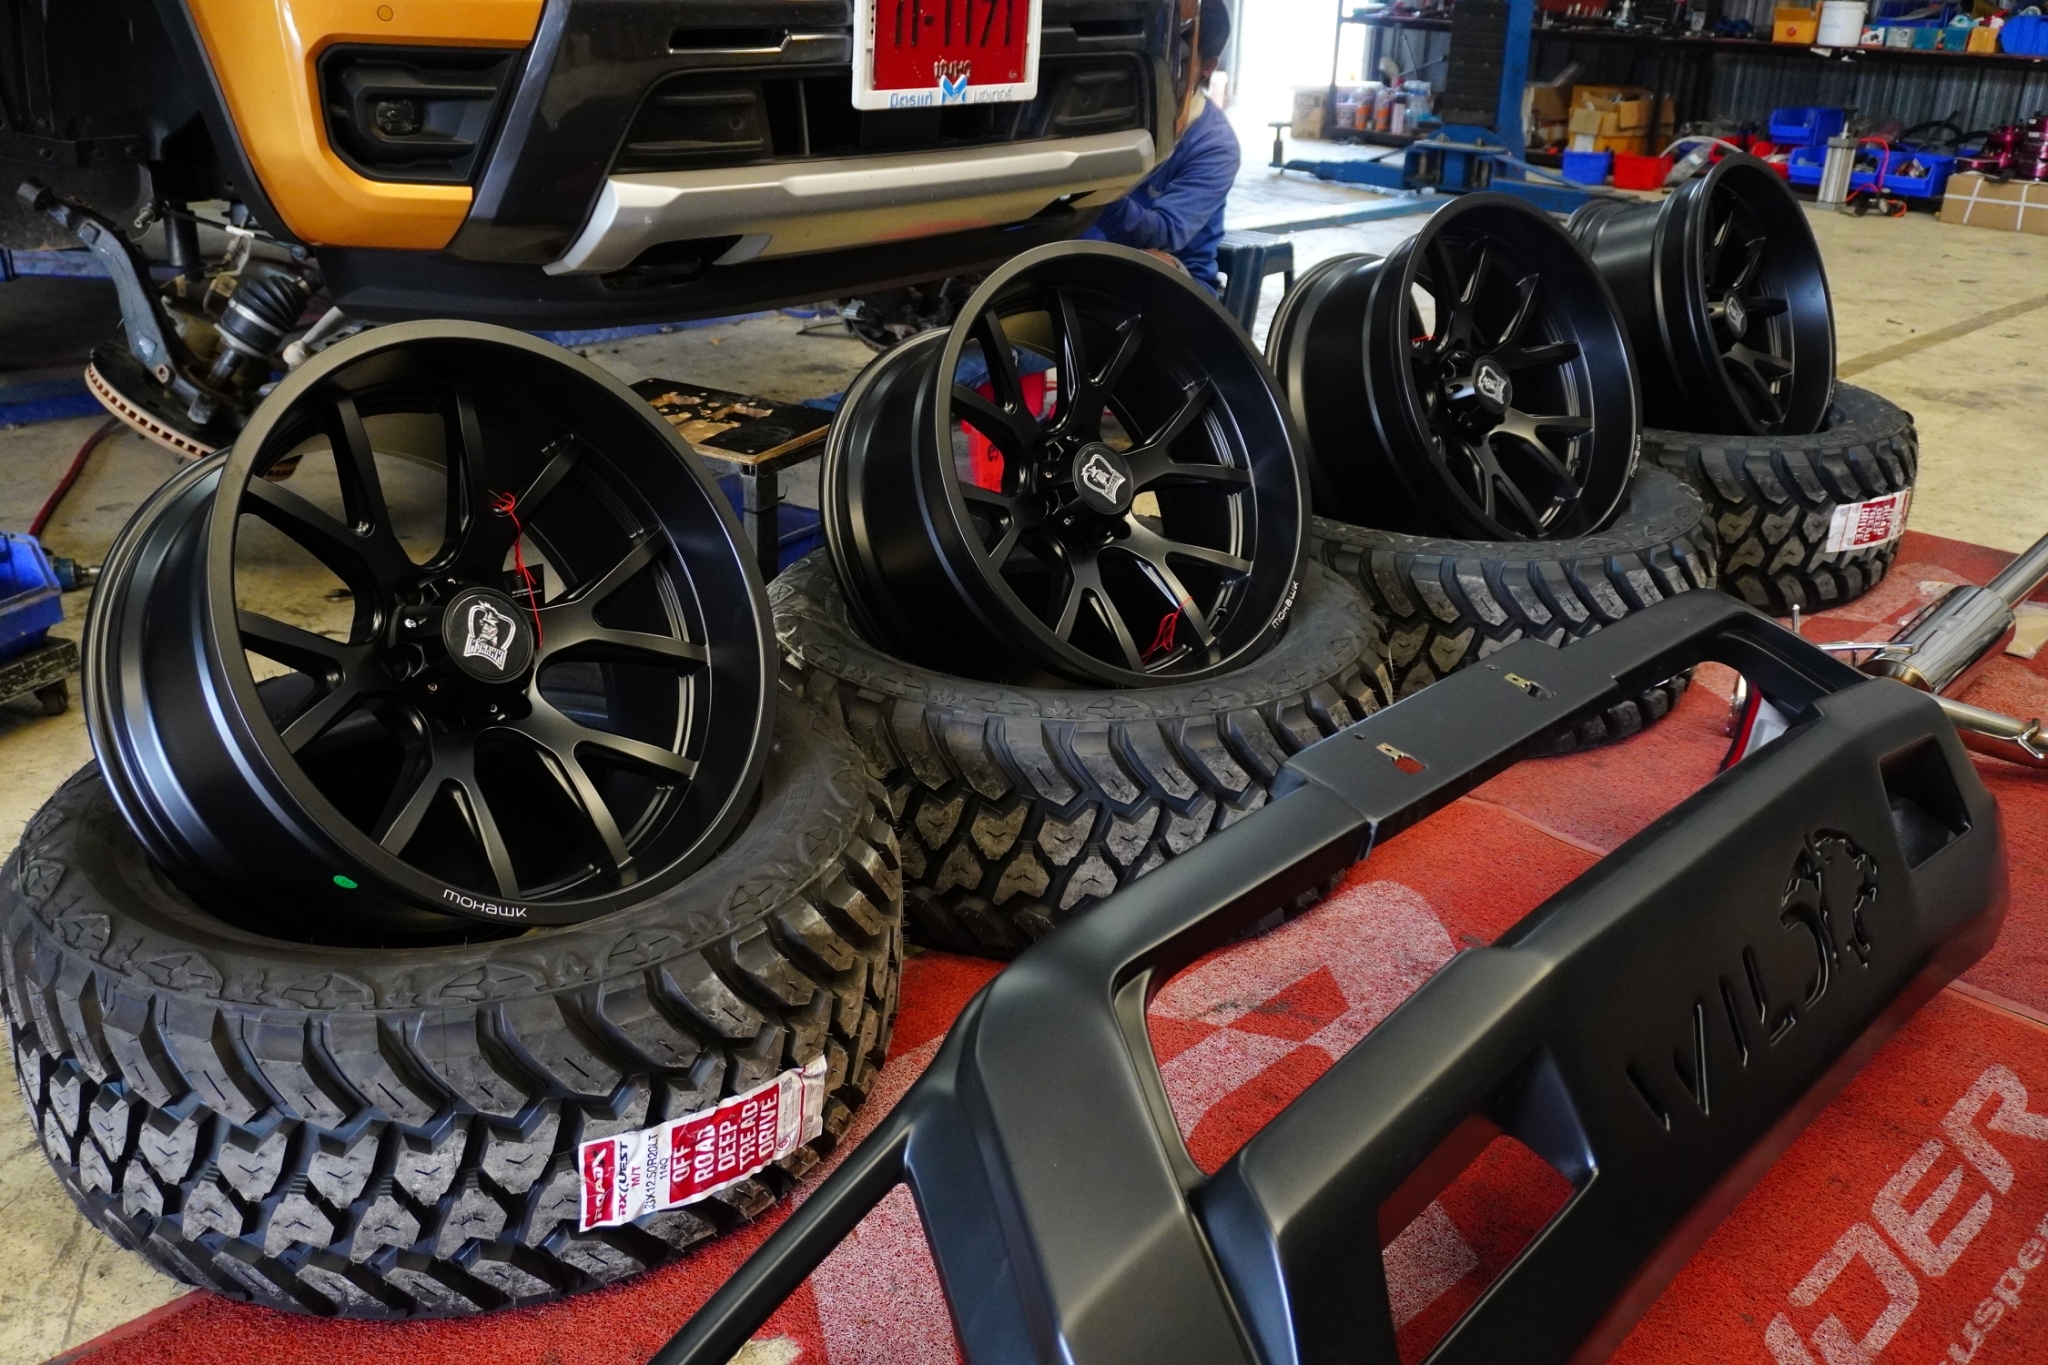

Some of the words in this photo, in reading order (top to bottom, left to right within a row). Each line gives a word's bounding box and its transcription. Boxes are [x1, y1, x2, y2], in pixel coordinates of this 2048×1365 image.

[717, 1121, 738, 1172] DEEP
[740, 1101, 758, 1171] TREAD
[758, 1093, 778, 1158] DRIVE
[631, 1166, 641, 1188] M/T
[659, 1157, 669, 1180] 114Q
[672, 1145, 692, 1183] OFF
[694, 1124, 716, 1183] ROAD
